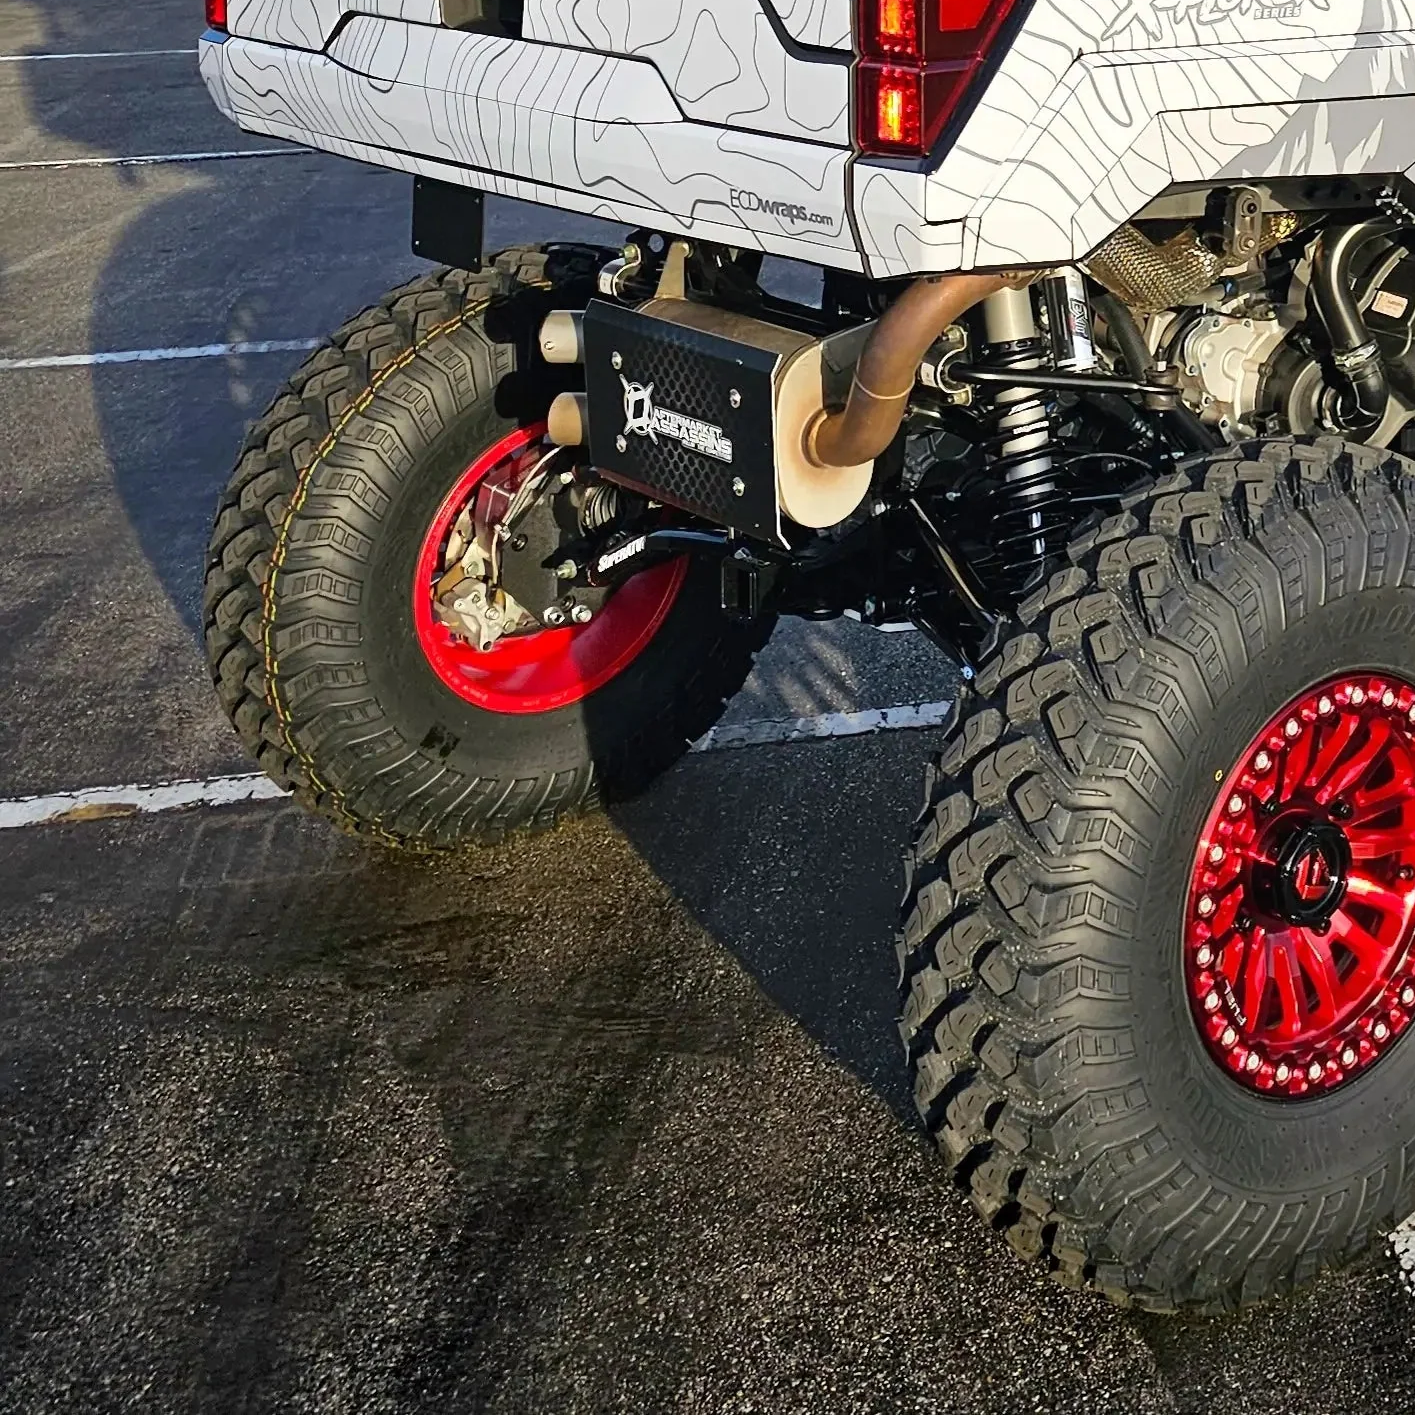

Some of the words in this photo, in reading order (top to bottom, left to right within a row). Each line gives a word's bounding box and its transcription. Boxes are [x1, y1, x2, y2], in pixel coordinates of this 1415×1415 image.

[1253, 5, 1301, 20] SERIES
[729, 188, 834, 226] ECDwraps.com
[650, 416, 732, 454] ASSASSINS
[653, 408, 722, 440] AFTERMARKET
[1224, 979, 1247, 1026] FUEL
